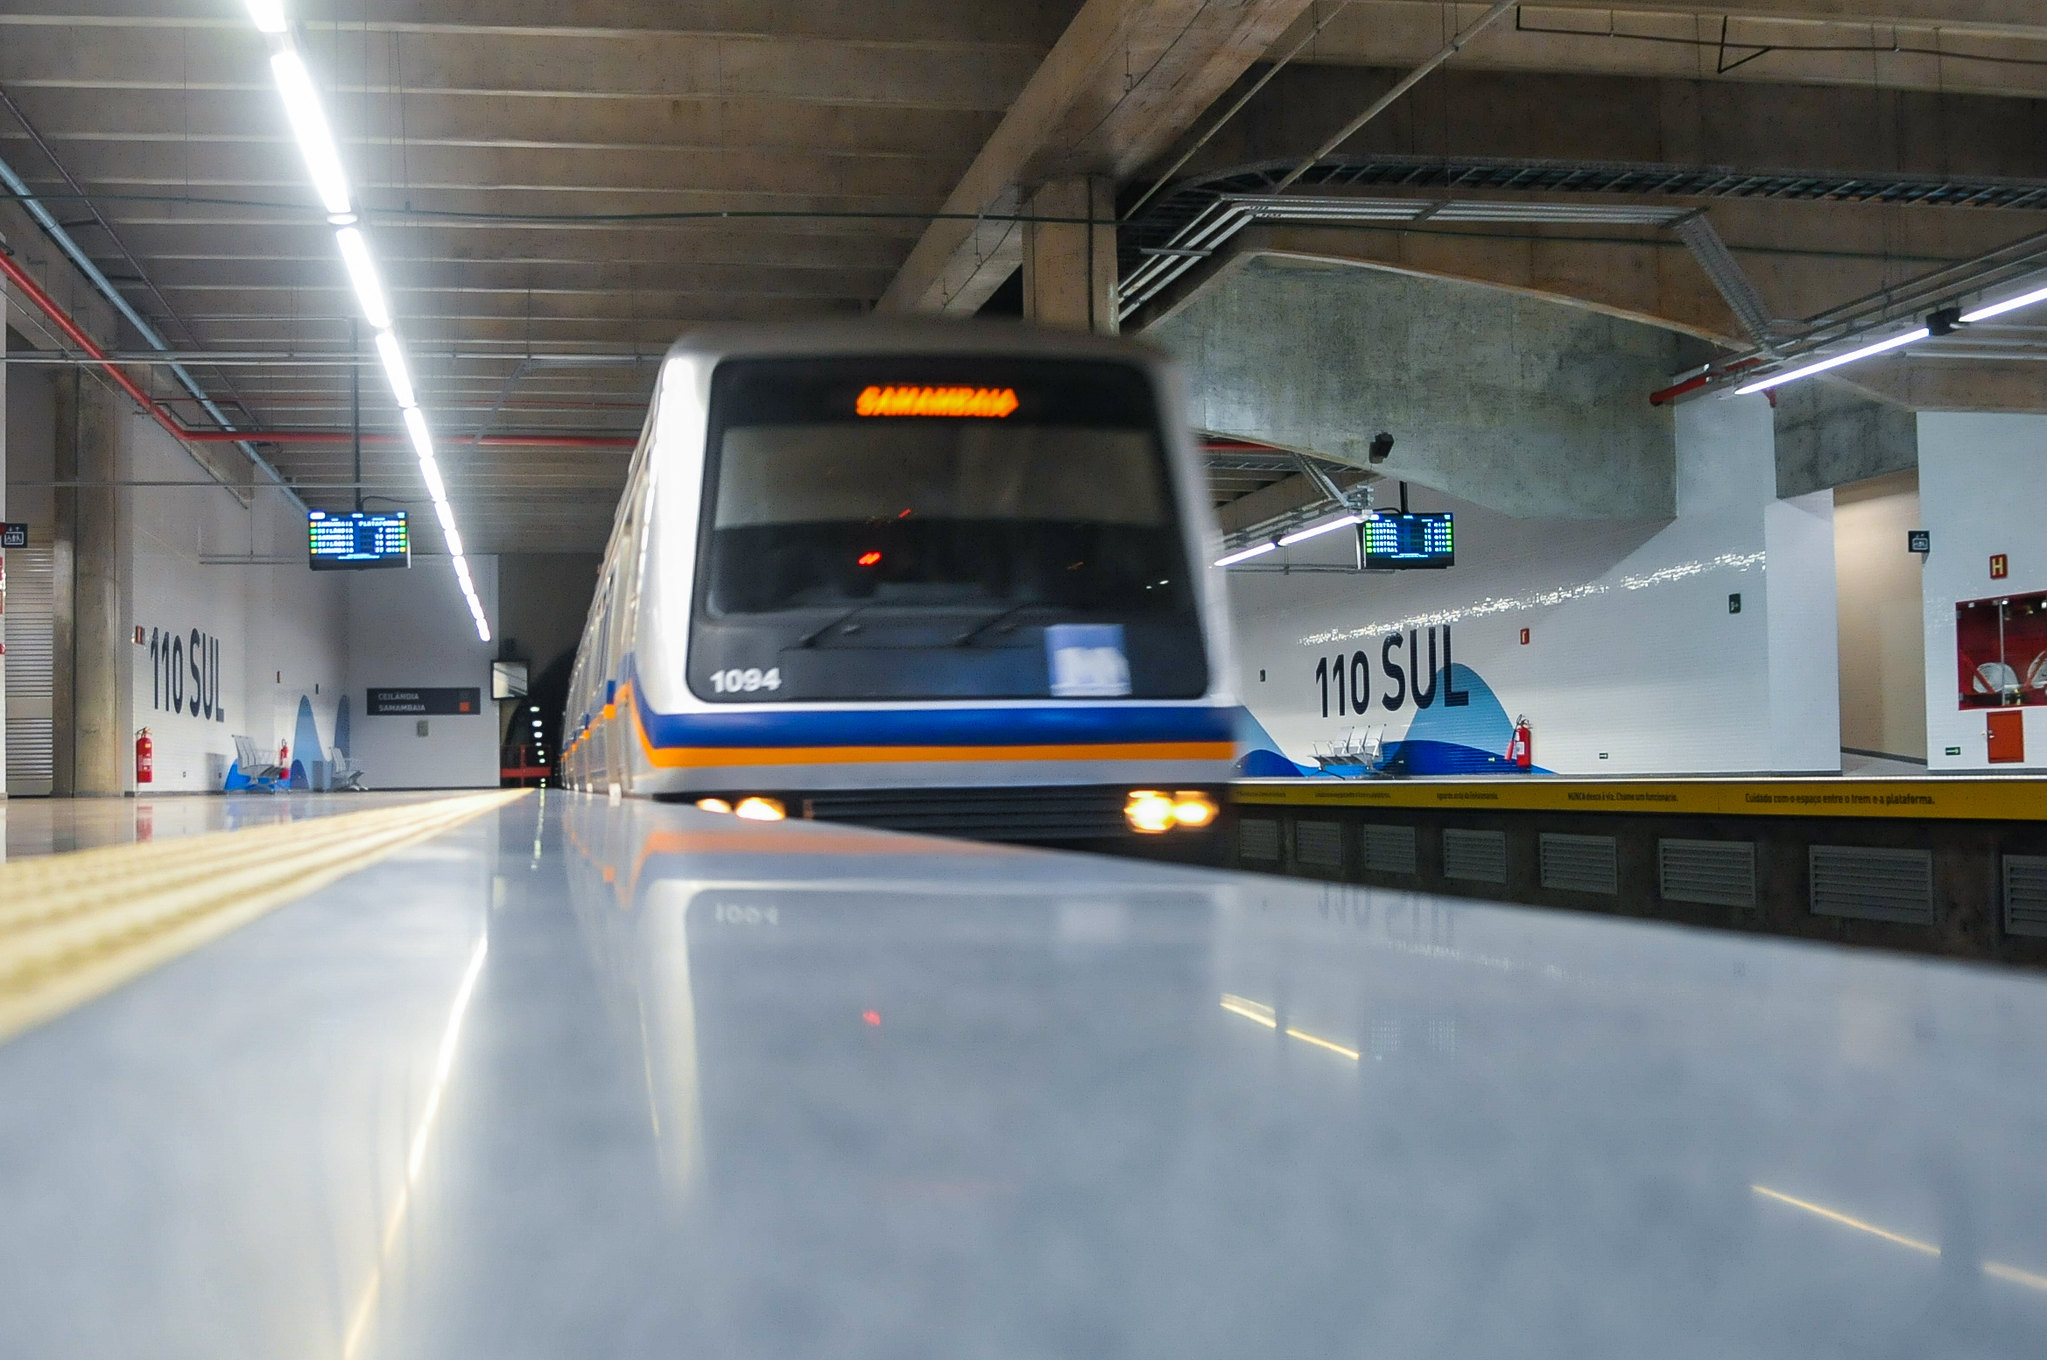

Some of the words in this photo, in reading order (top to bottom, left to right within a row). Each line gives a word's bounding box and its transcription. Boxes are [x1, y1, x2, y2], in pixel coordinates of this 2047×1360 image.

[1992, 556, 2004, 576] H
[150, 626, 184, 714] 110
[190, 628, 224, 722] SUL
[710, 667, 782, 693] 1094
[1316, 650, 1370, 718] 110
[1382, 624, 1469, 712] SUL
[1745, 793, 1772, 803] Cuidado
[1823, 794, 1843, 804] entre
[1851, 794, 1871, 804] trem
[1872, 796, 1878, 804] e
[1880, 796, 1884, 804] a
[1886, 793, 1935, 807] plataforma.
